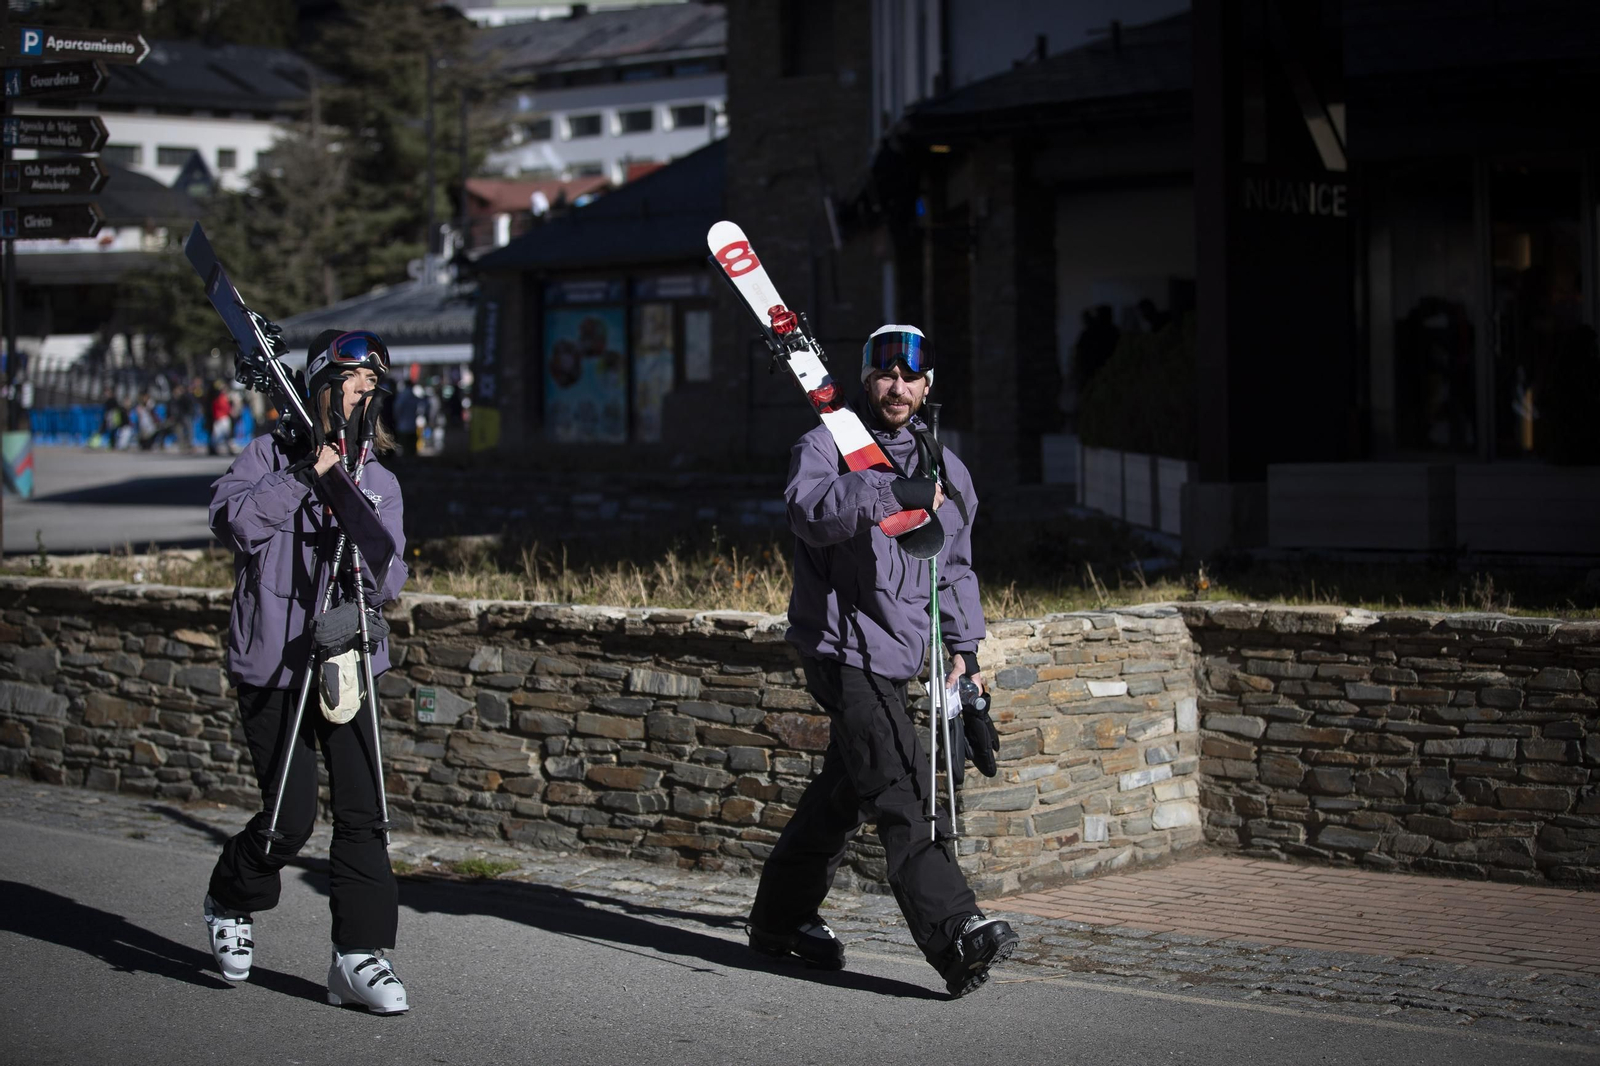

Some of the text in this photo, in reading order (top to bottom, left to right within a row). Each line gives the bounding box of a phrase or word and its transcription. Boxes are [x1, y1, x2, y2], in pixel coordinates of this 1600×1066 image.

[24, 31, 135, 54] P Aparcamiento
[1244, 177, 1348, 217] NUANCE
